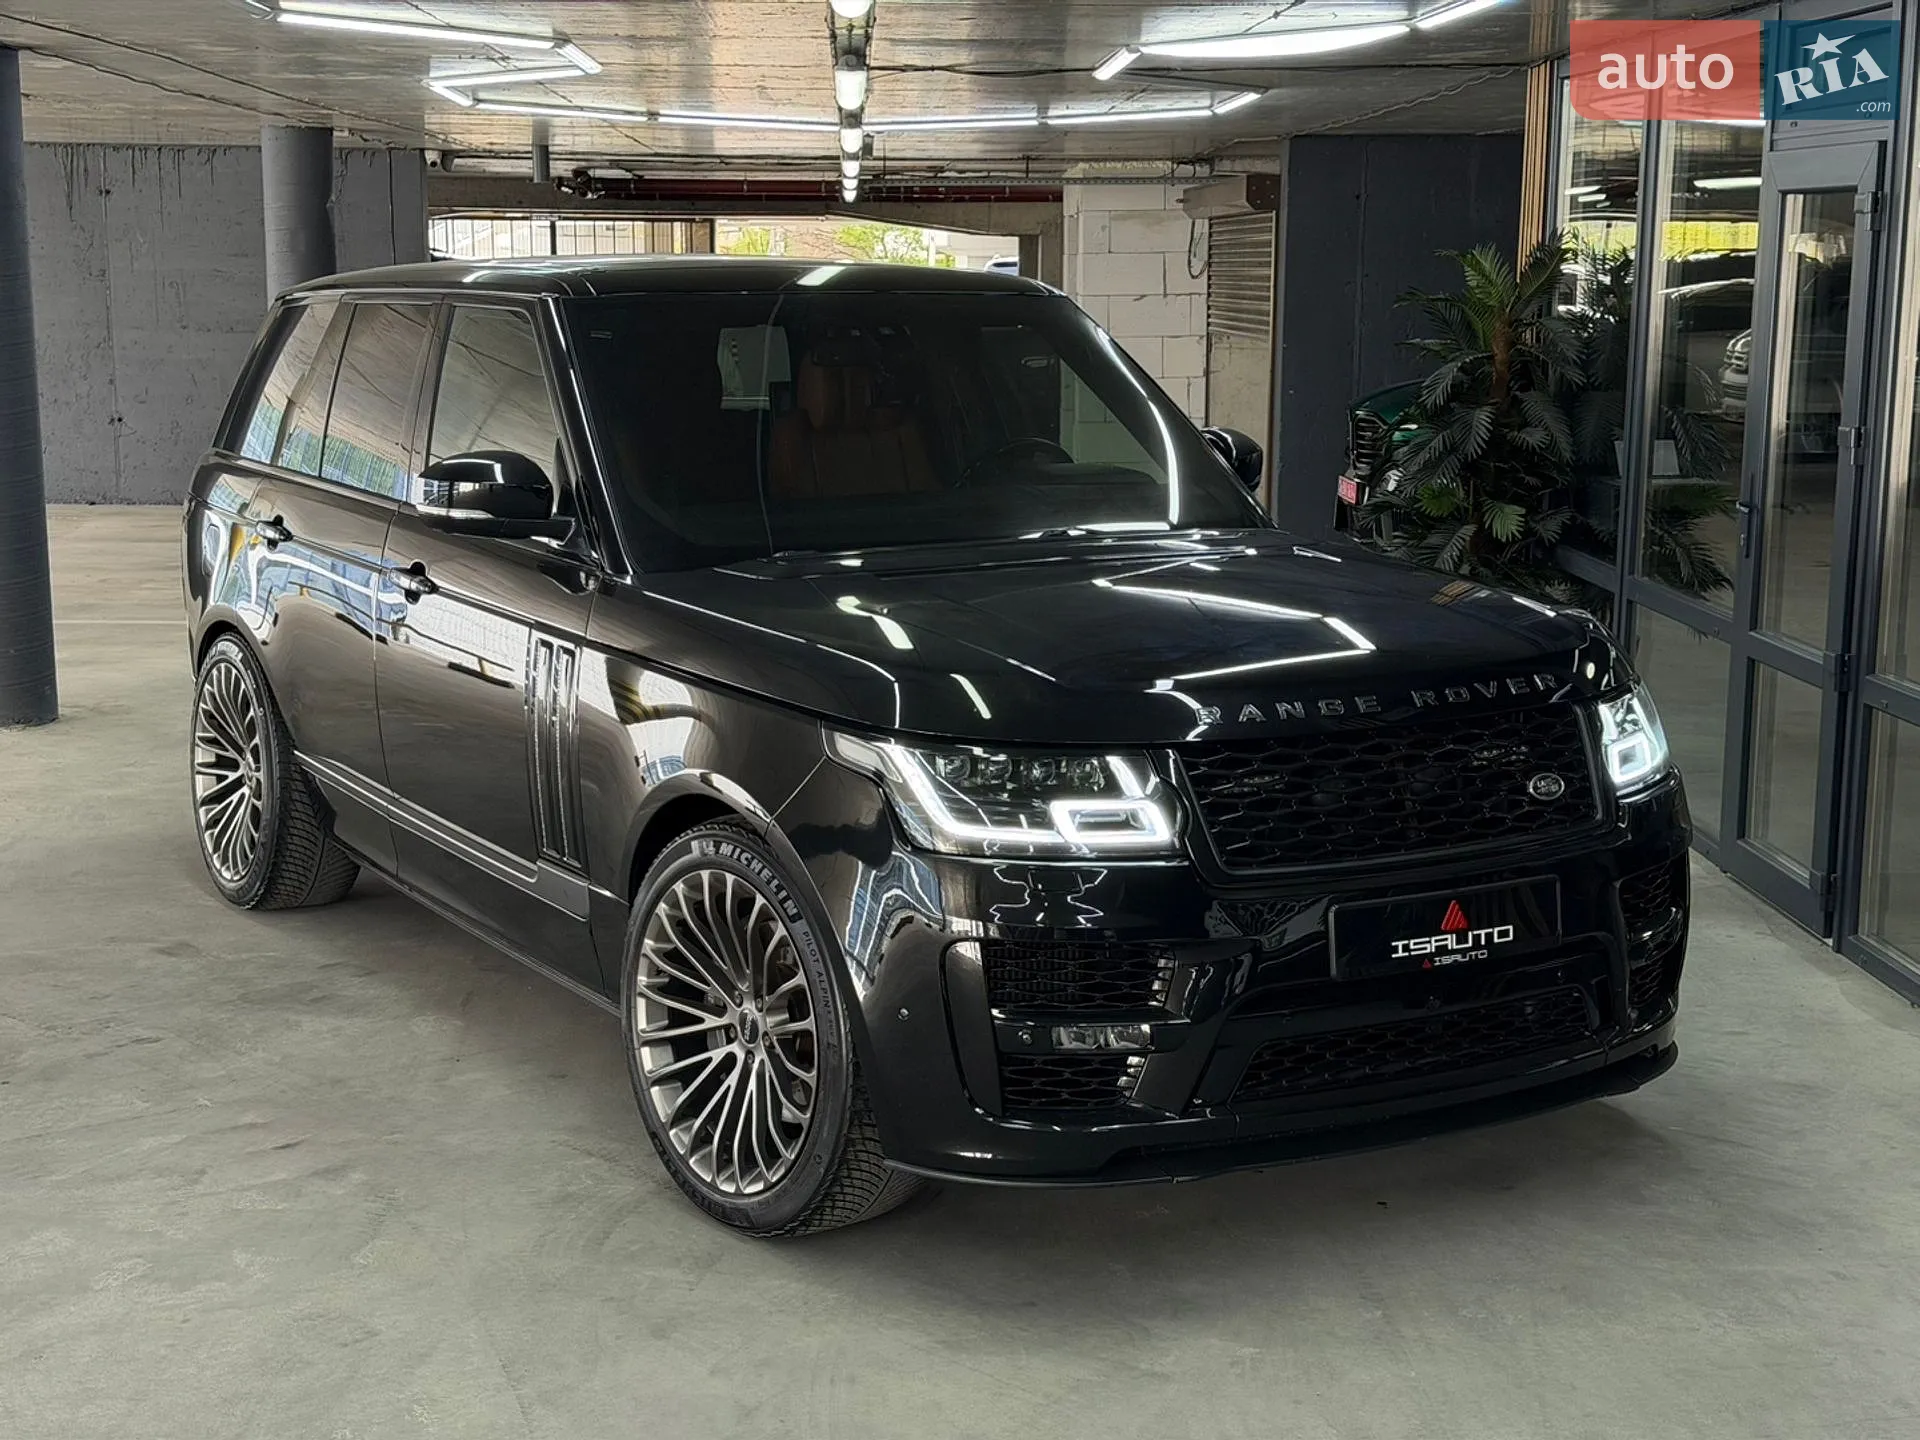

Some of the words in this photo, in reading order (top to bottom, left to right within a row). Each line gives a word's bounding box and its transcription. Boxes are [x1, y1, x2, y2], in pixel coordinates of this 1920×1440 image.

[1197, 696, 1381, 725] RANGE
[1411, 674, 1557, 707] ROVER
[719, 843, 798, 916] MICHELIN
[803, 931, 820, 964] PILOT
[1391, 925, 1514, 958] ISAUTO
[1433, 949, 1488, 966] ISAUTO
